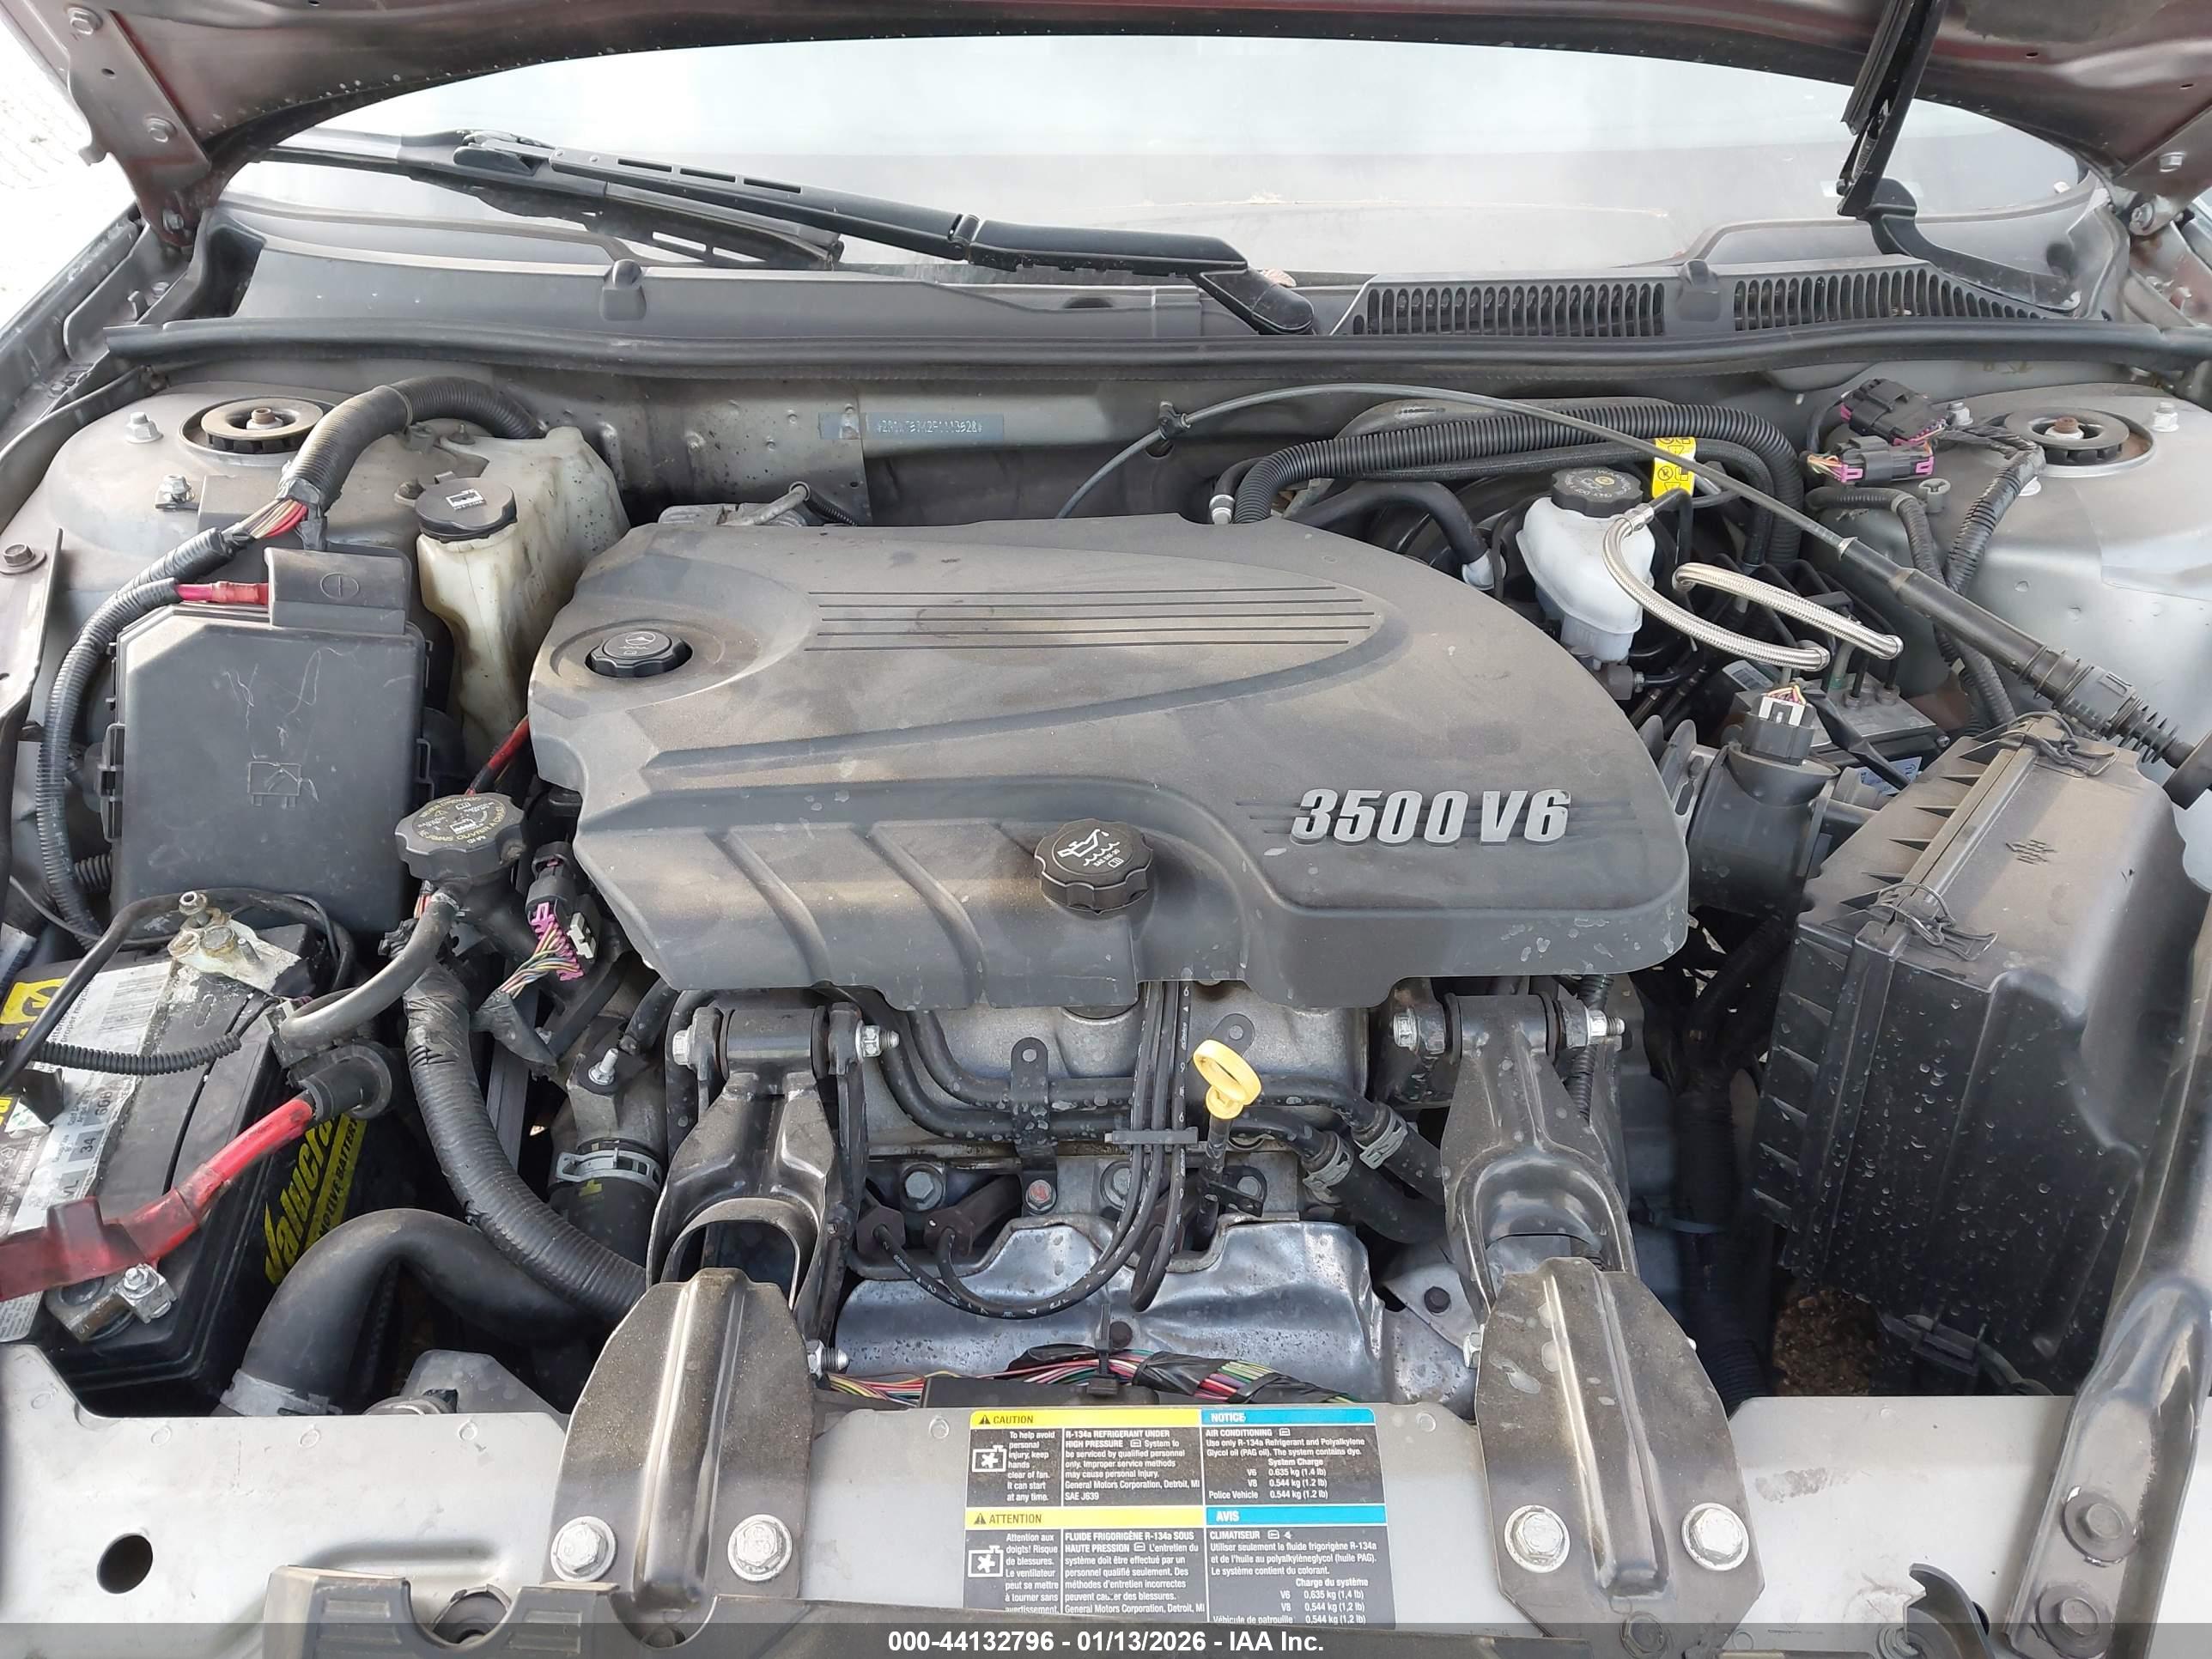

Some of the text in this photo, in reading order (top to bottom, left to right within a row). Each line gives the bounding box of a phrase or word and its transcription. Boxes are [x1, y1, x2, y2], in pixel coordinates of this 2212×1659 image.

[1290, 788, 1572, 846] 3500 V6
[80, 1137, 96, 1153] 34
[1211, 1413, 1246, 1422] NOTICE
[1019, 1431, 1035, 1441] help
[1009, 1441, 1040, 1449] personal
[1145, 1440, 1170, 1449] System
[1221, 1439, 1236, 1448] only
[1265, 1438, 1304, 1448] Refrigerant
[1321, 1438, 1364, 1447] Polyalkylene
[1009, 1451, 1048, 1460] injury, keep
[1076, 1449, 1103, 1458] serviced
[1105, 1449, 1115, 1458] by
[1118, 1449, 1146, 1458] qualified
[1147, 1449, 1185, 1458] personnel
[1206, 1449, 1228, 1457] Glycol
[1240, 1448, 1257, 1457] (PAG
[1259, 1448, 1271, 1457] oil).
[1347, 1448, 1361, 1456] dye.
[1066, 1460, 1082, 1469] only.
[1084, 1460, 1115, 1469] Improper
[1066, 1470, 1080, 1479] may
[1105, 1470, 1136, 1479] personal
[1138, 1470, 1159, 1479] injury.
[1120, 1480, 1162, 1490] Corporation,
[1164, 1480, 1189, 1490] Detroit,
[1291, 1480, 1301, 1488] kg
[1303, 1480, 1316, 1488] (1.2
[1318, 1480, 1327, 1488] lb)
[1016, 1493, 1029, 1502] any
[989, 1514, 1042, 1523] ATTENTION
[1216, 1511, 1239, 1522] AVIS
[1065, 1531, 1194, 1540] FLUIDE FRIGORIGÈNE R-134a SOUS
[1210, 1531, 1260, 1540] CLIMATISEUR
[1006, 1546, 1057, 1555] doigts! Risque
[1065, 1544, 1090, 1553] HAUTE
[1091, 1544, 1129, 1553] PRESSION
[1189, 1543, 1199, 1552] du
[1006, 1569, 1055, 1577] Le ventilateur
[1065, 1569, 1101, 1578] personnel
[1103, 1568, 1130, 1577] qualifié
[1222, 1567, 1253, 1576] système
[1006, 1582, 1021, 1590] peut
[1066, 1580, 1186, 1589] méthodes d'entretien incorrectes
[1296, 1578, 1322, 1587] Charge
[1337, 1578, 1368, 1587] système
[1066, 1592, 1095, 1601] peuvent
[1065, 1605, 1092, 1613] General
[1095, 1605, 1120, 1613] Motors
[1121, 1604, 1165, 1614] Corporation,
[1168, 1604, 1194, 1613] Detroit,
